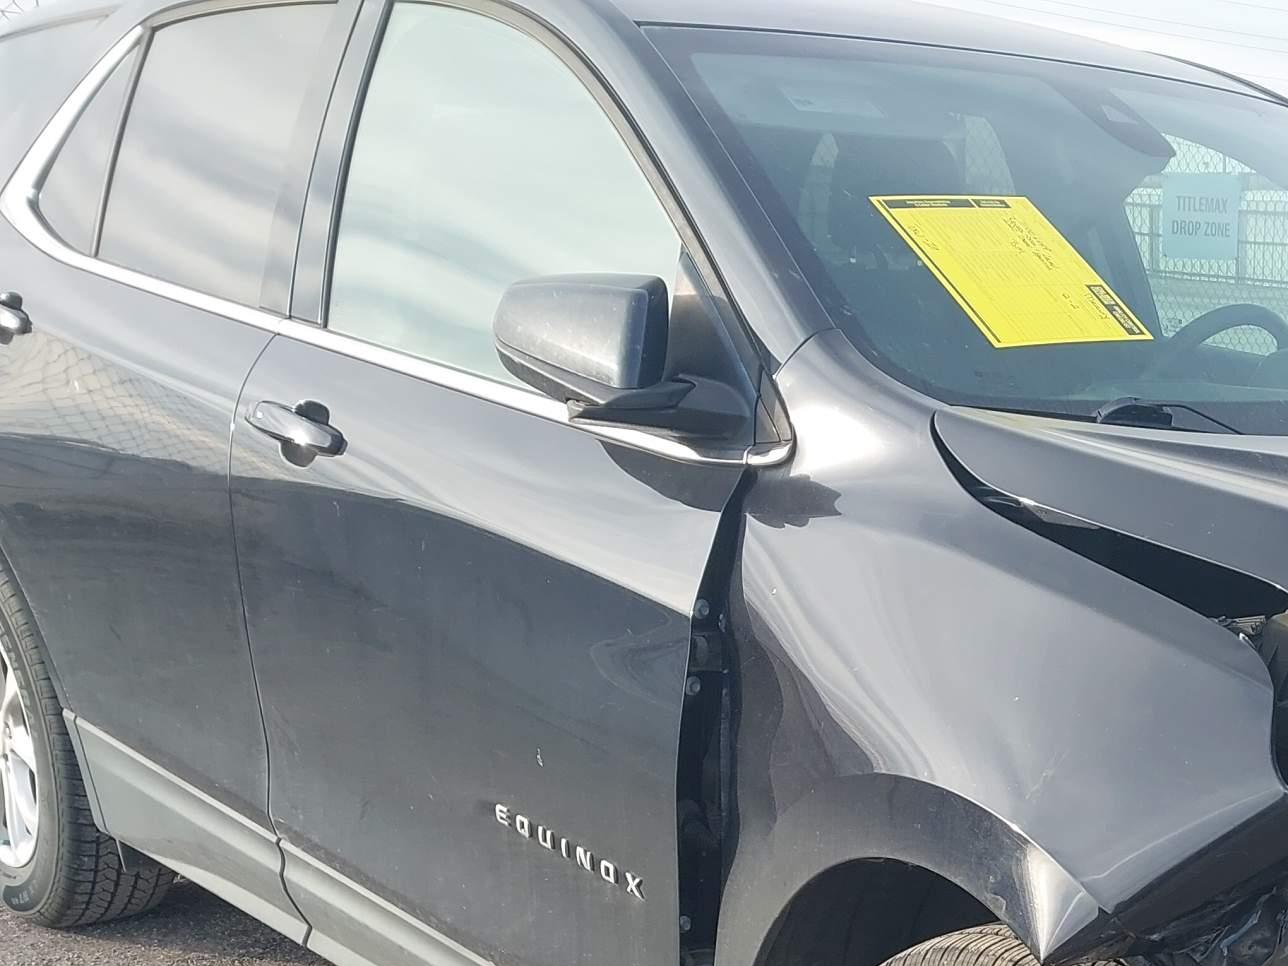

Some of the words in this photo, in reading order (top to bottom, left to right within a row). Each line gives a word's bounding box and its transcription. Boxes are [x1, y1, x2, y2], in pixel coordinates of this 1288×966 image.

[1175, 195, 1229, 214] TITLEMAX
[1171, 219, 1201, 237] DROP
[1203, 221, 1231, 238] ZONE
[494, 803, 646, 901] EQUINOX
